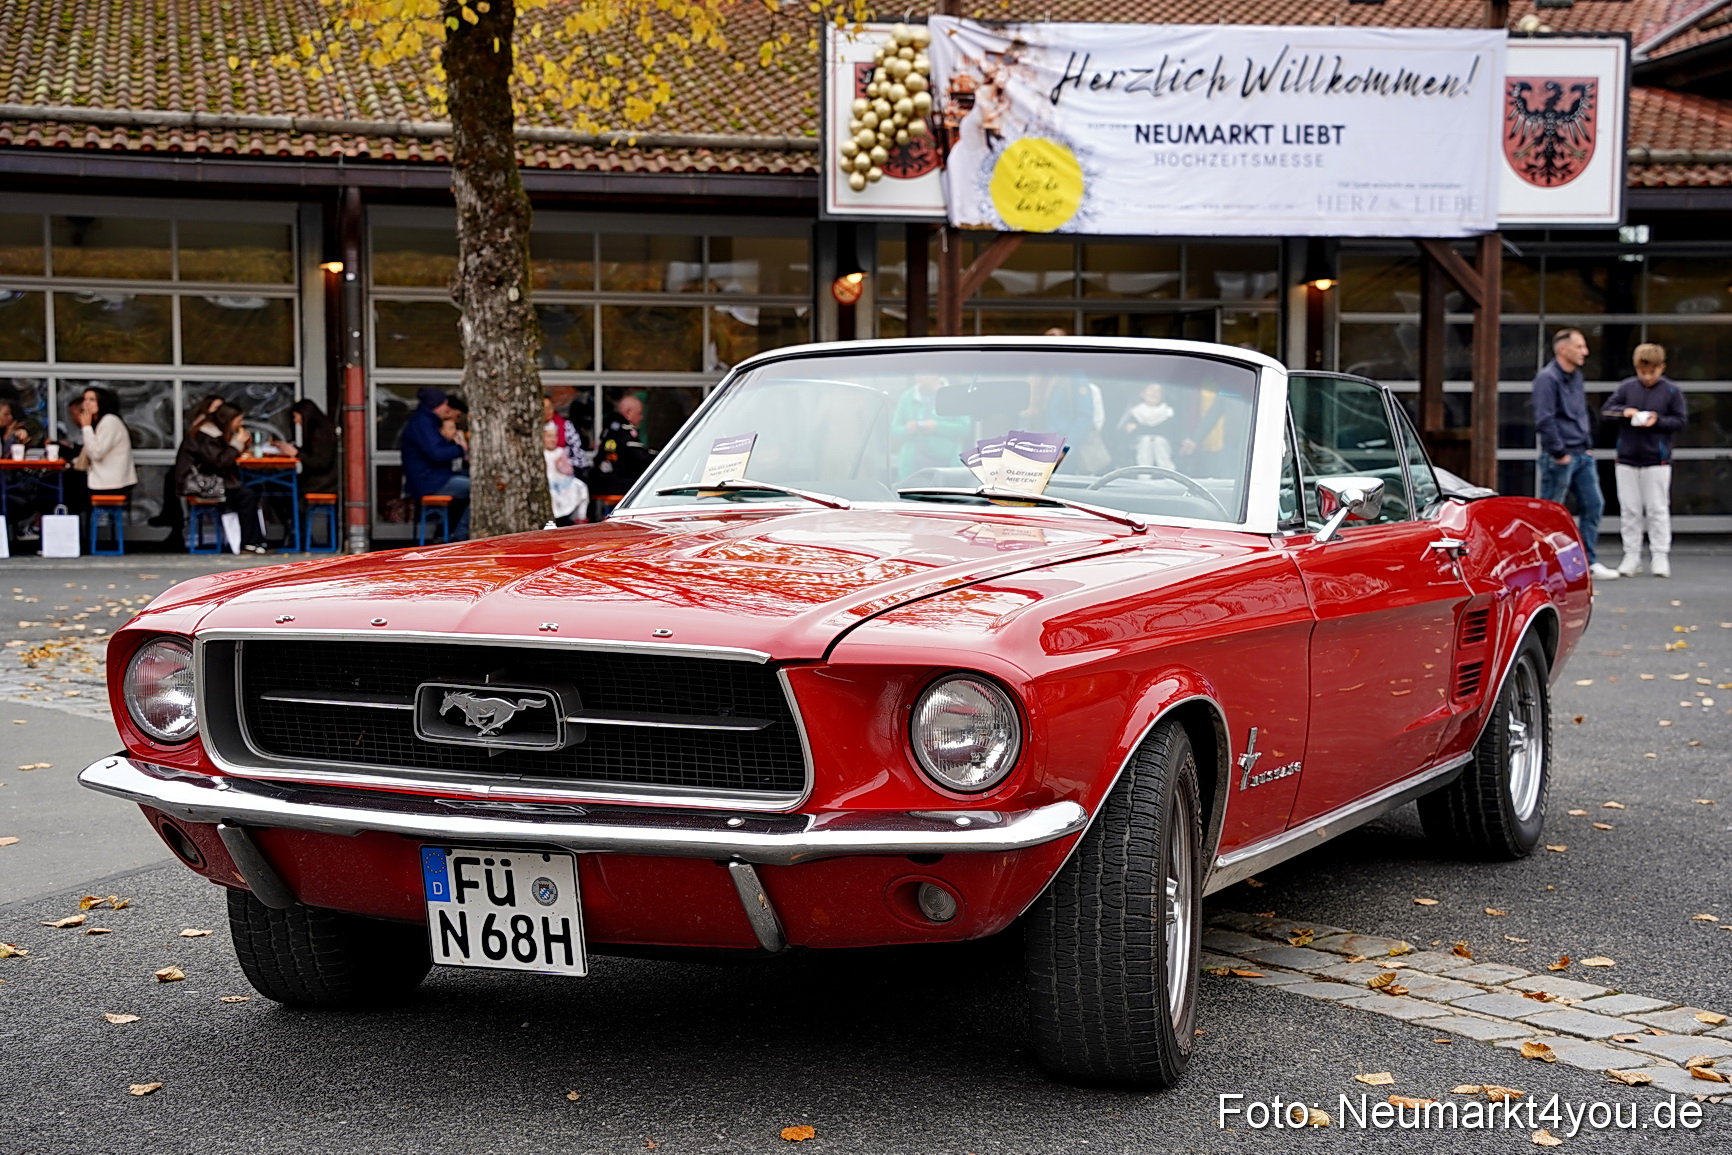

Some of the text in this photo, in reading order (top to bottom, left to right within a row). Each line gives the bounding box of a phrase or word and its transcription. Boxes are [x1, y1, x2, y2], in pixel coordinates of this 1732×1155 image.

[1050, 45, 1480, 105] Herzlich Willkommen!
[1135, 124, 1345, 145] NEUMARKT LIEBT
[1154, 152, 1324, 168] HOCHZEITSMESSE
[1006, 469, 1044, 477] OLDTIMER
[433, 881, 443, 895] D
[453, 856, 516, 908] FÜ
[438, 909, 574, 966] N 68H
